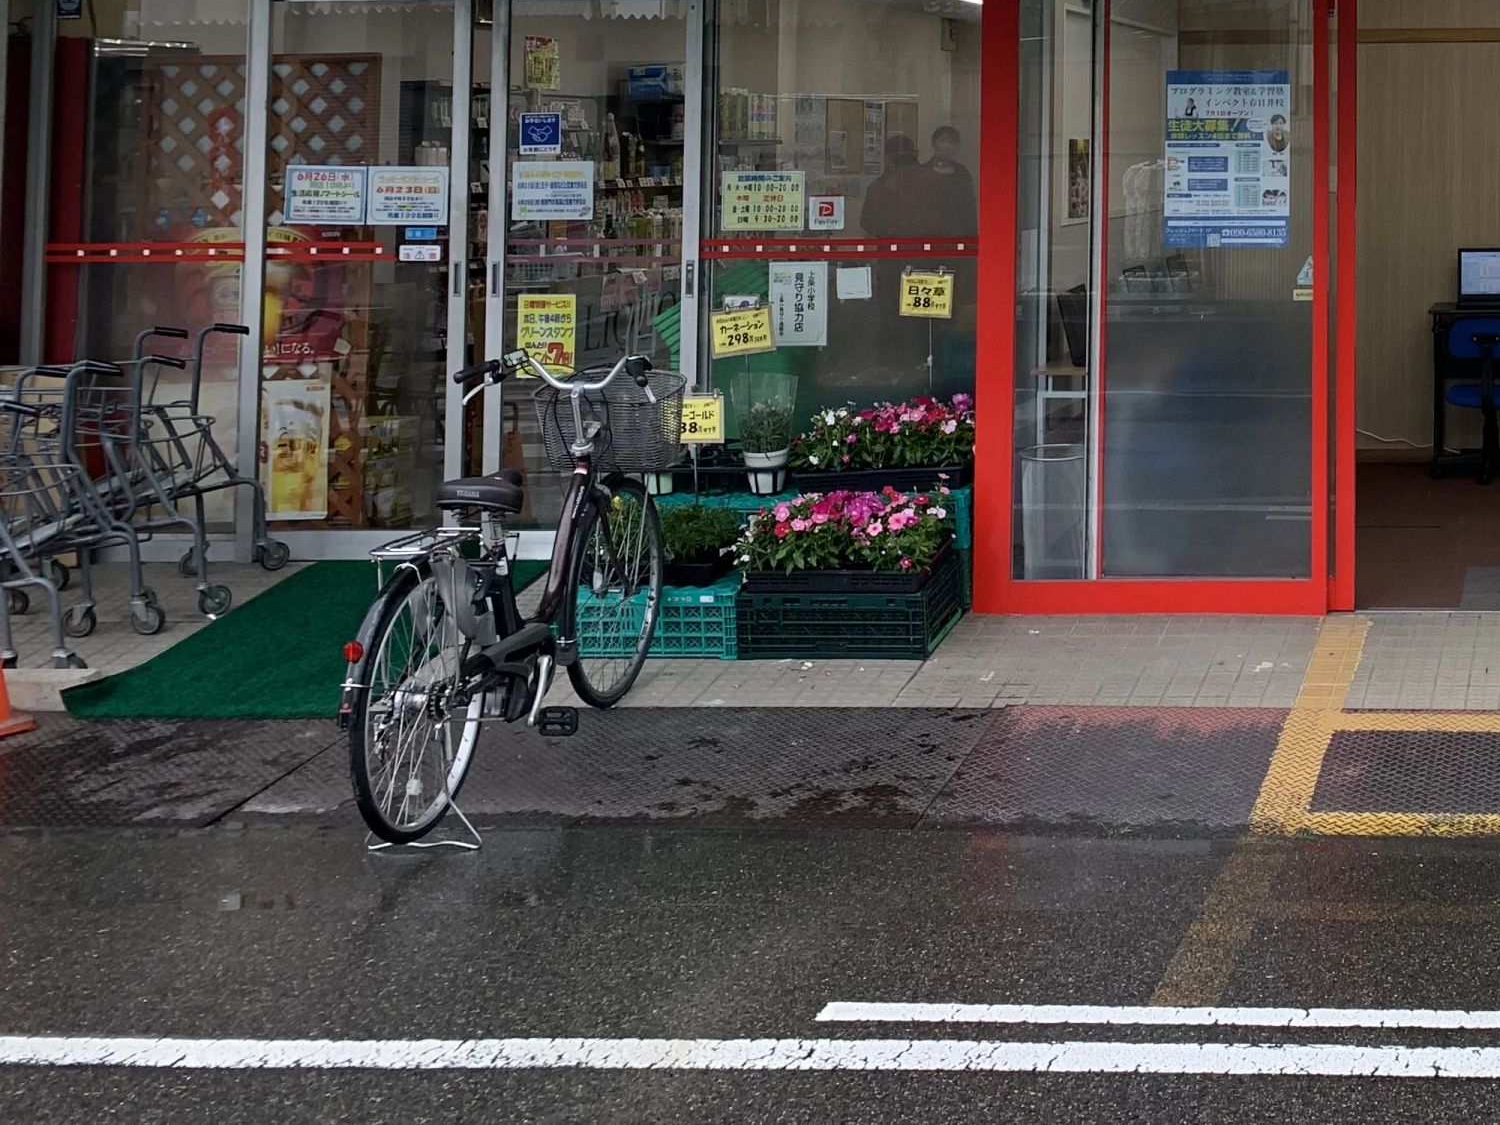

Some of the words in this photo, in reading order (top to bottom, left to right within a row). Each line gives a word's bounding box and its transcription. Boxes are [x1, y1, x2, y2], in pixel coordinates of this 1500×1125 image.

[908, 285, 946, 296] 日々草
[794, 272, 805, 333] 見守り協力店
[720, 320, 764, 335] カーネーション
